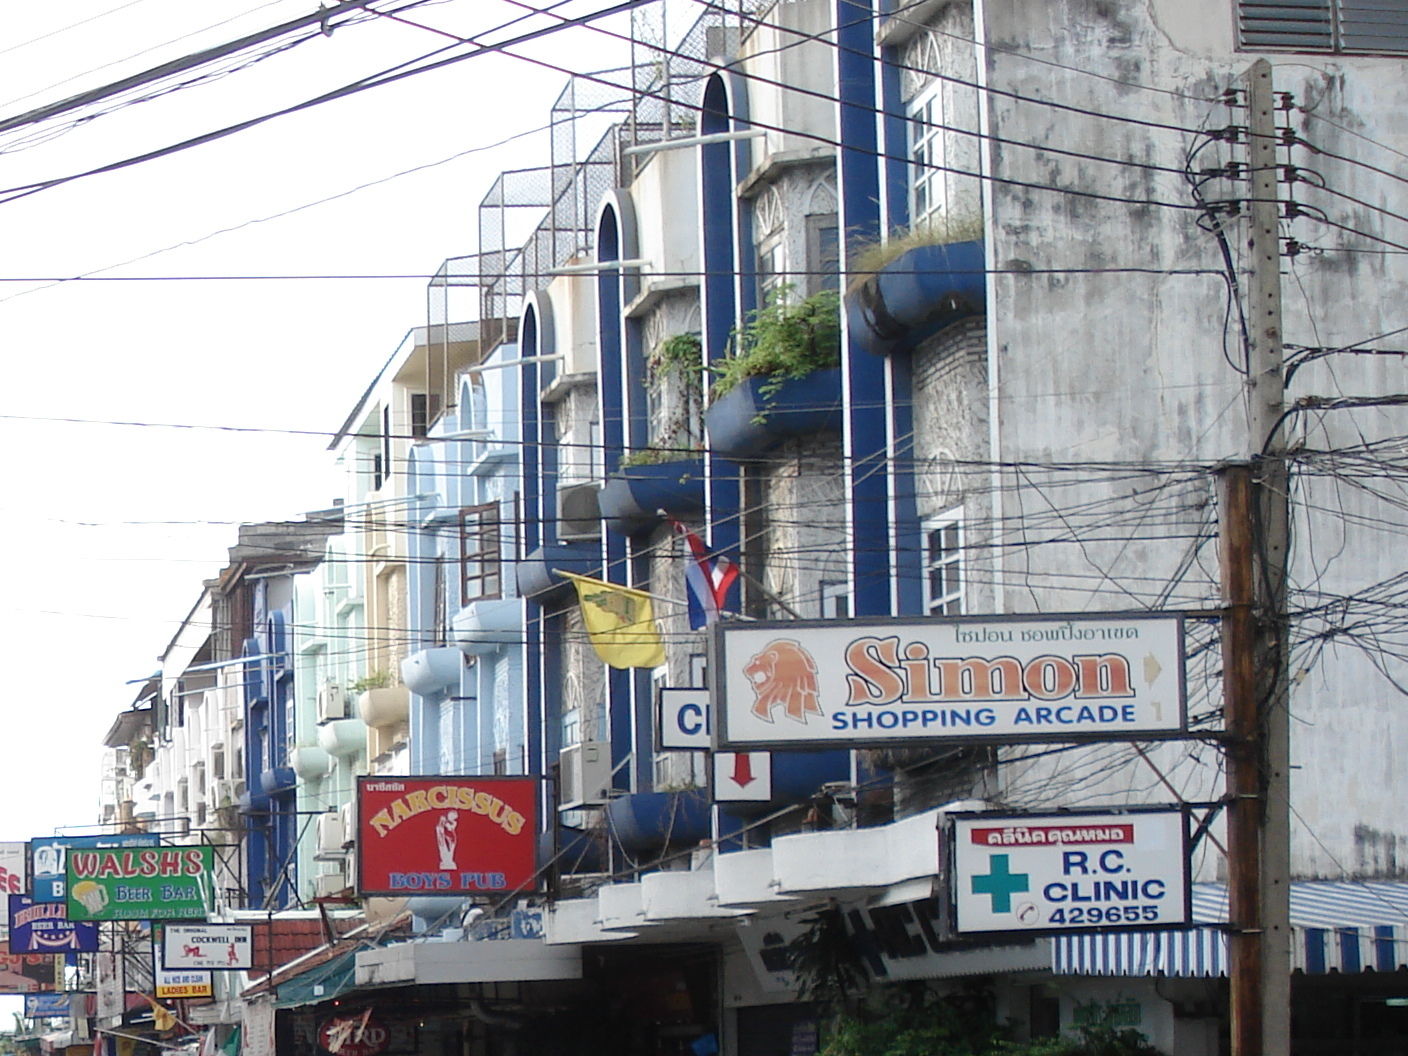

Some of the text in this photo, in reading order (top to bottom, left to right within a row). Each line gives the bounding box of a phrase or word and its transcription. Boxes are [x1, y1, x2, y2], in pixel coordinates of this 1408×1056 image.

[844, 635, 1137, 707] Simon
[831, 705, 1136, 731] SHOPPING ARCADE
[369, 785, 526, 838] NARCISSUS
[71, 849, 205, 879] WALSHS
[1062, 849, 1132, 876] R.C.
[389, 872, 507, 890] BOYS PUB
[1042, 879, 1166, 904] CLINIC
[1048, 905, 1160, 926] 429655
[191, 936, 230, 944] COCKWELL
[162, 986, 208, 995] LADIES BAR
[328, 1024, 385, 1047] IRD
